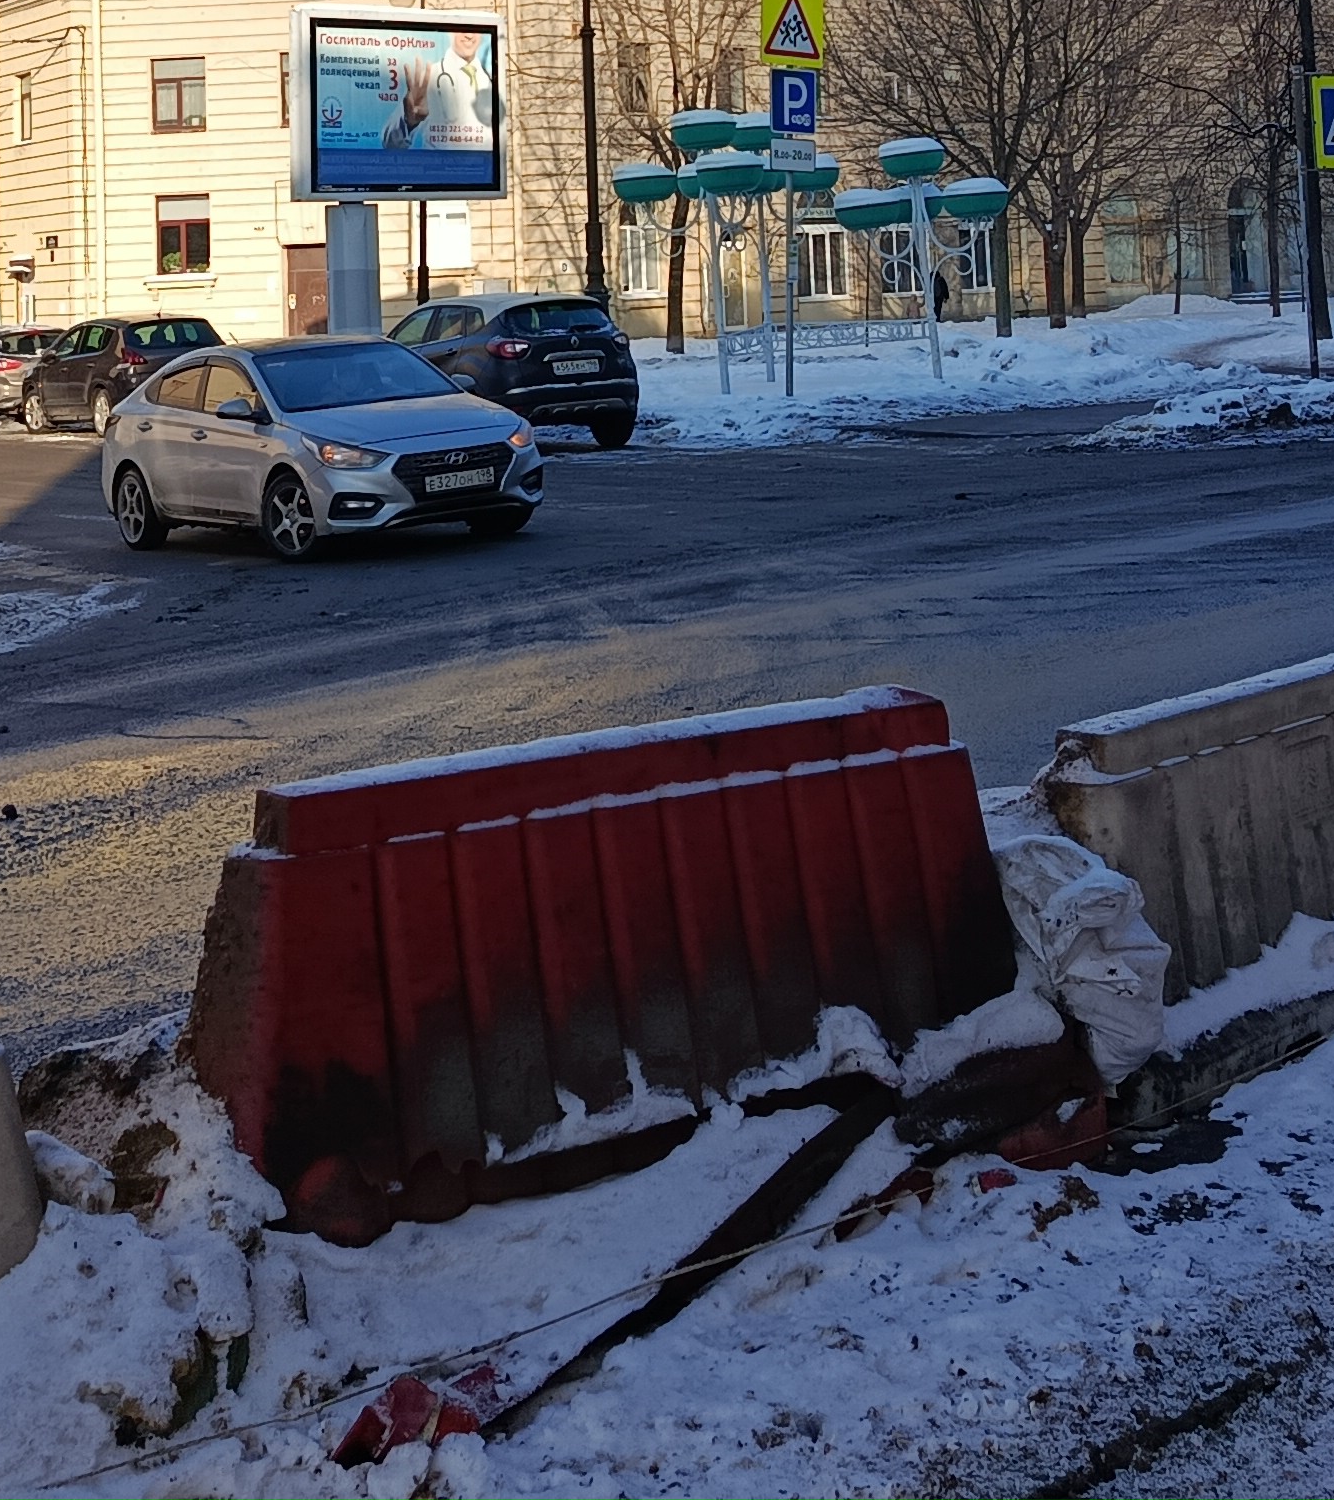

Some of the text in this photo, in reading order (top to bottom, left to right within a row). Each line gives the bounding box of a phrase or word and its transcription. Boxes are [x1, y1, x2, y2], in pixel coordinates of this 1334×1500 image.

[320, 33, 381, 47] Госпиталь
[319, 53, 380, 65] Комплексный
[386, 57, 397, 67] за
[389, 69, 399, 91] 3
[354, 81, 380, 90] чекап
[378, 93, 399, 102] часа
[783, 76, 808, 126] P
[429, 124, 448, 133] (812)
[429, 135, 448, 143] (812)
